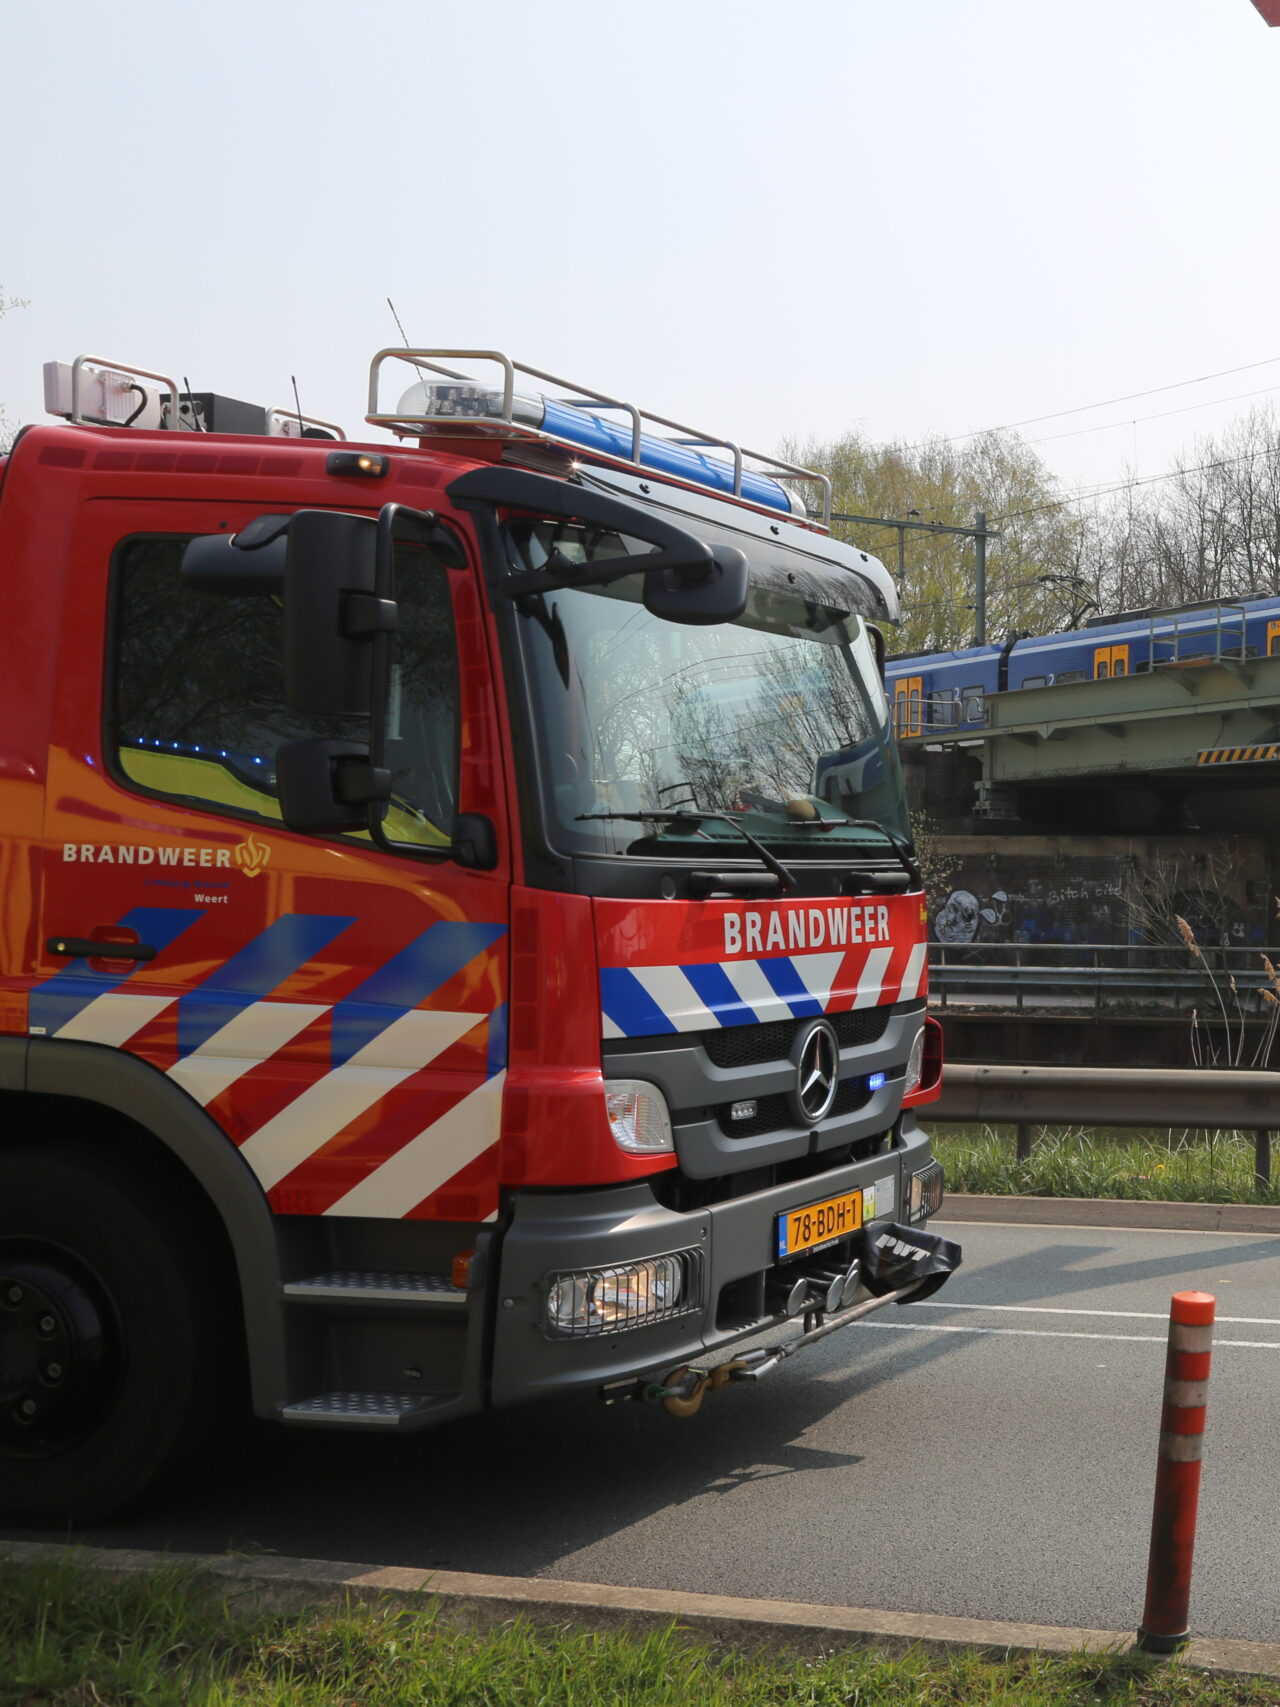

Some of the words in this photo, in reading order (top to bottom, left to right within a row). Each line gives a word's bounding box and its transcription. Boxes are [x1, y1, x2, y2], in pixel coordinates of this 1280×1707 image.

[1048, 673, 1055, 686] 2
[954, 687, 960, 701] 2
[63, 843, 231, 868] BRANDWEER
[194, 893, 229, 904] Weert
[723, 905, 890, 954] BRANDWEER
[793, 1197, 856, 1246] 78-BDH-1
[779, 1240, 787, 1250] NL
[875, 1233, 931, 1262] PWT
